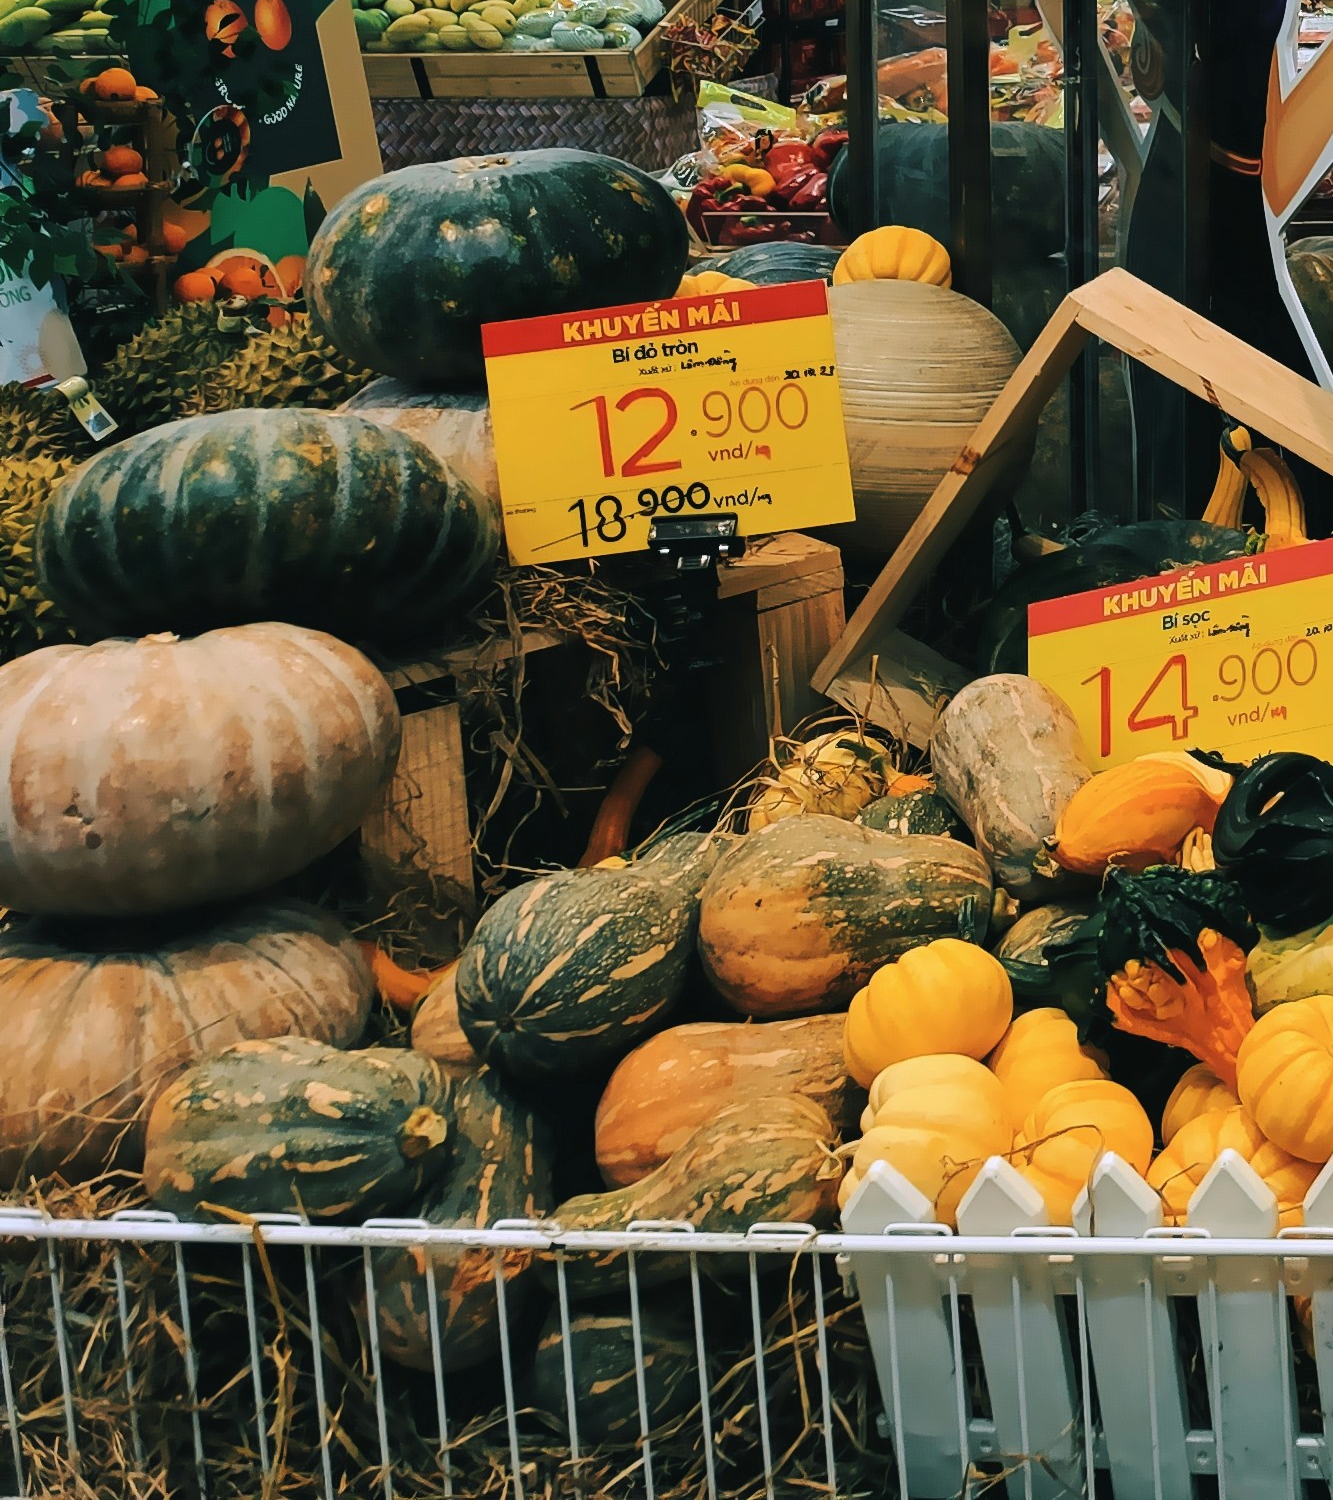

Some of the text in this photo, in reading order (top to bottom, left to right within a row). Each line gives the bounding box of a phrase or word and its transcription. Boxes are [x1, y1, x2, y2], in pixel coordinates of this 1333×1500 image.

[562, 297, 741, 344] KHUYẾN MÃI
[612, 338, 699, 364] Bí đỏ tròn
[569, 382, 809, 479] 12.900
[567, 481, 711, 548] 18.900
[1102, 562, 1268, 617] KHUYẾN MÃI
[1162, 611, 1179, 630] Bí
[1181, 610, 1211, 628] sọc
[1080, 638, 1318, 758] 14.900
